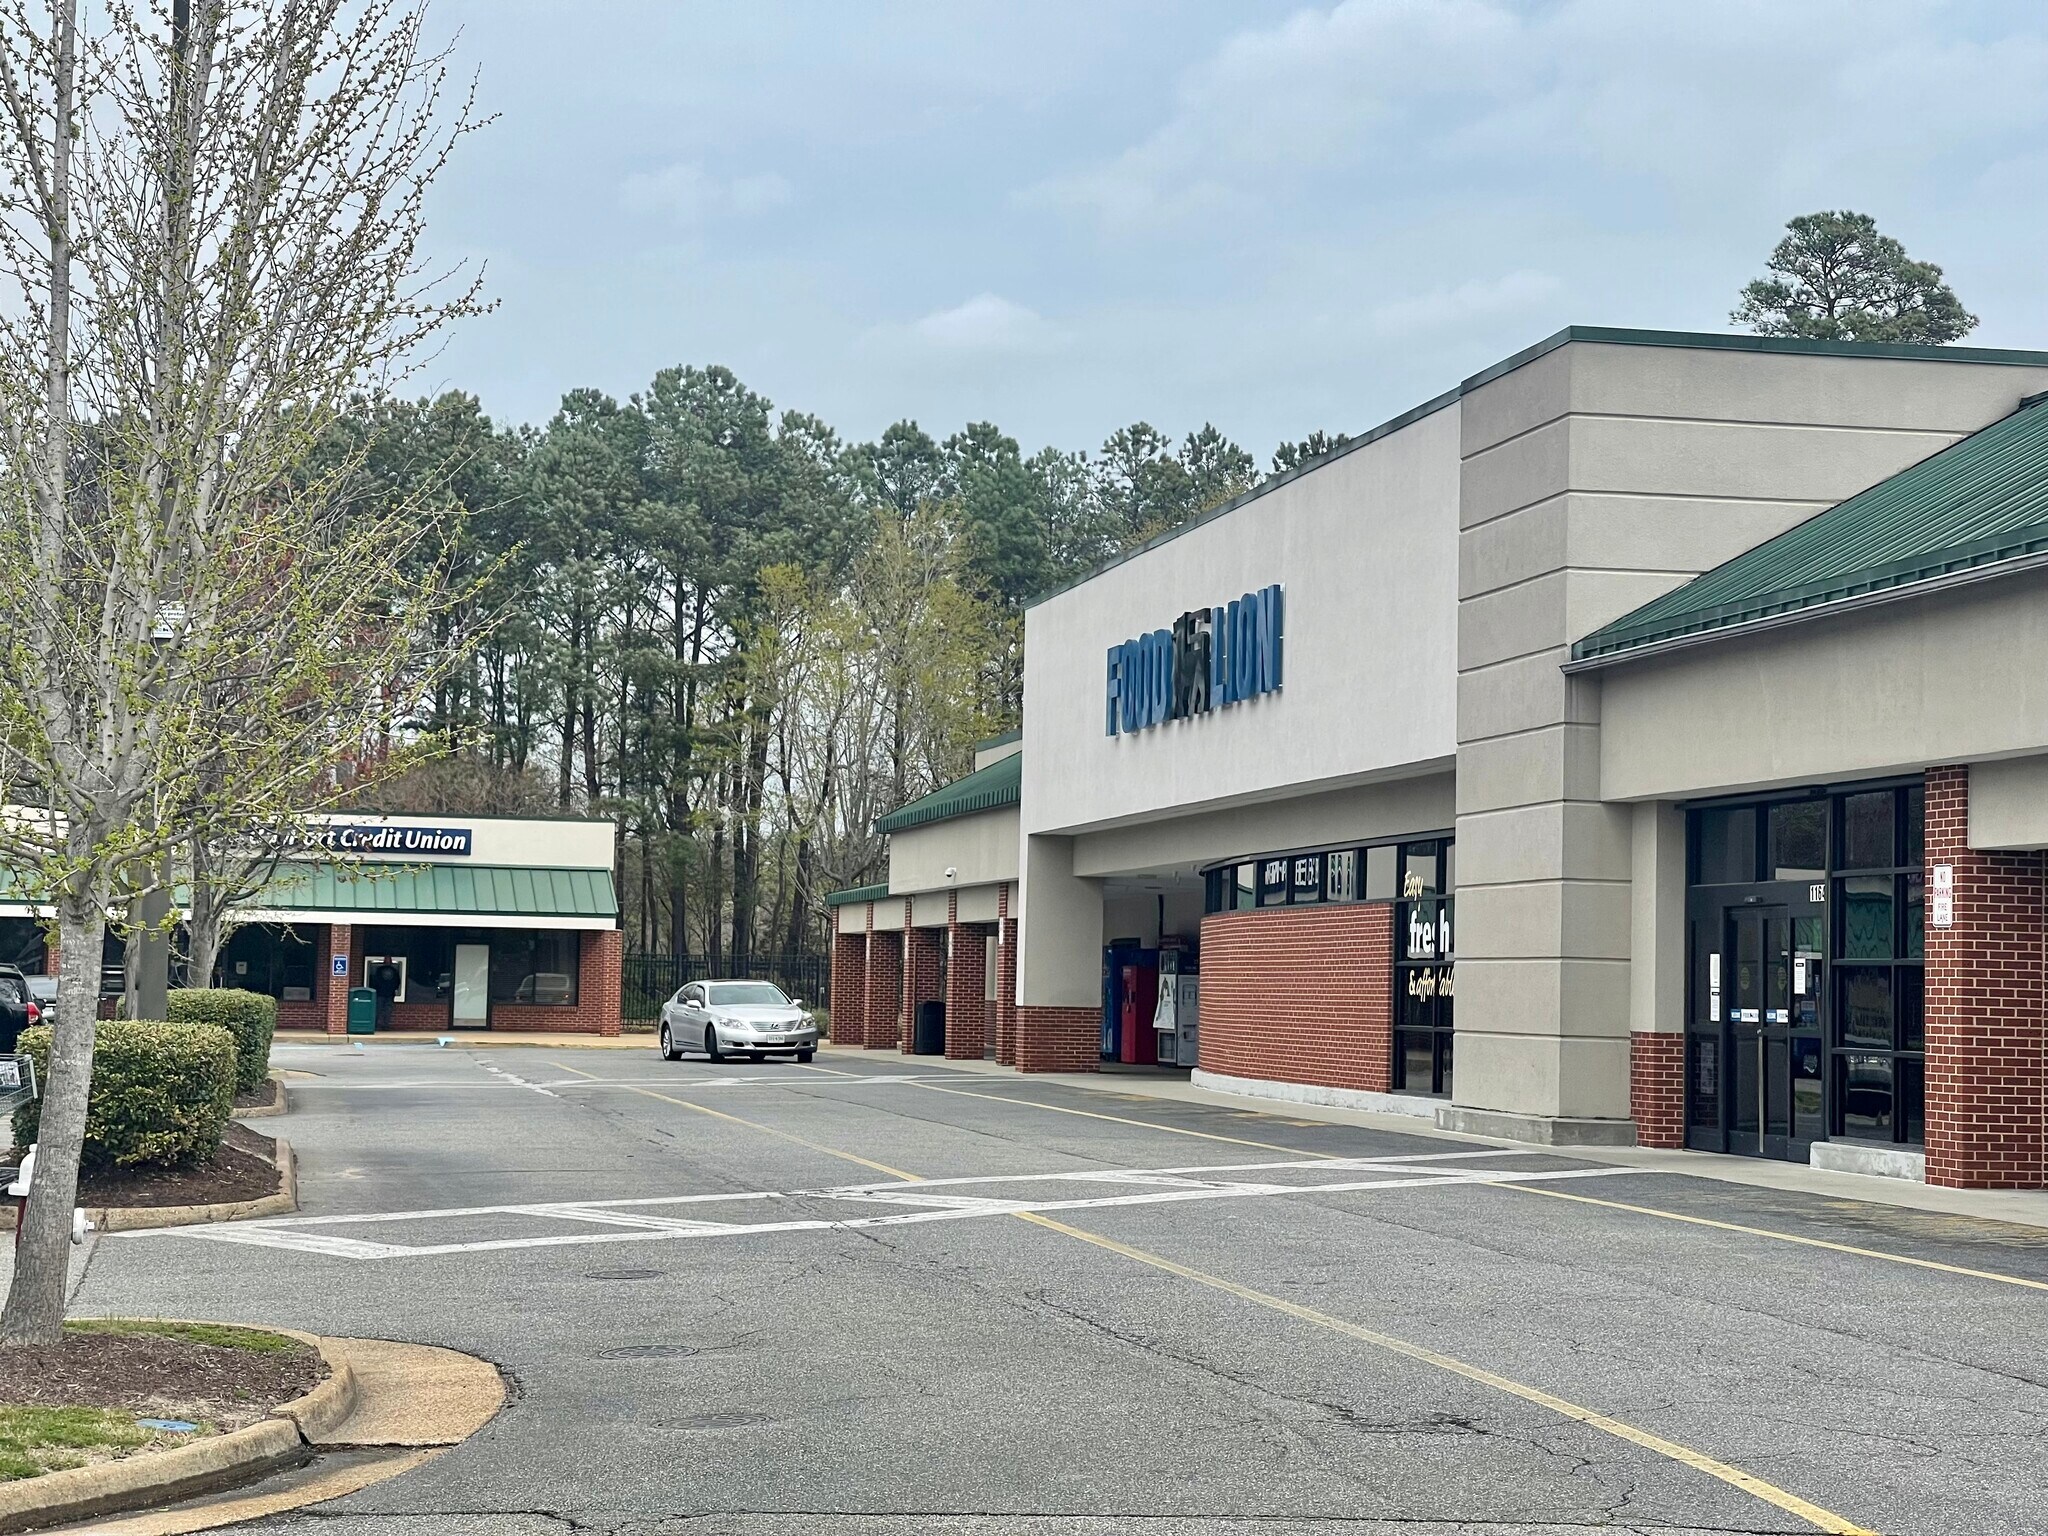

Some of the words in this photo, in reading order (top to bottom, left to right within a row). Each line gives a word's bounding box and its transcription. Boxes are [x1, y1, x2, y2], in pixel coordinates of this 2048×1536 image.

[1105, 629, 1174, 736] FOOD
[1210, 584, 1283, 708] LION
[340, 828, 402, 847] Credit
[405, 830, 466, 849] Union
